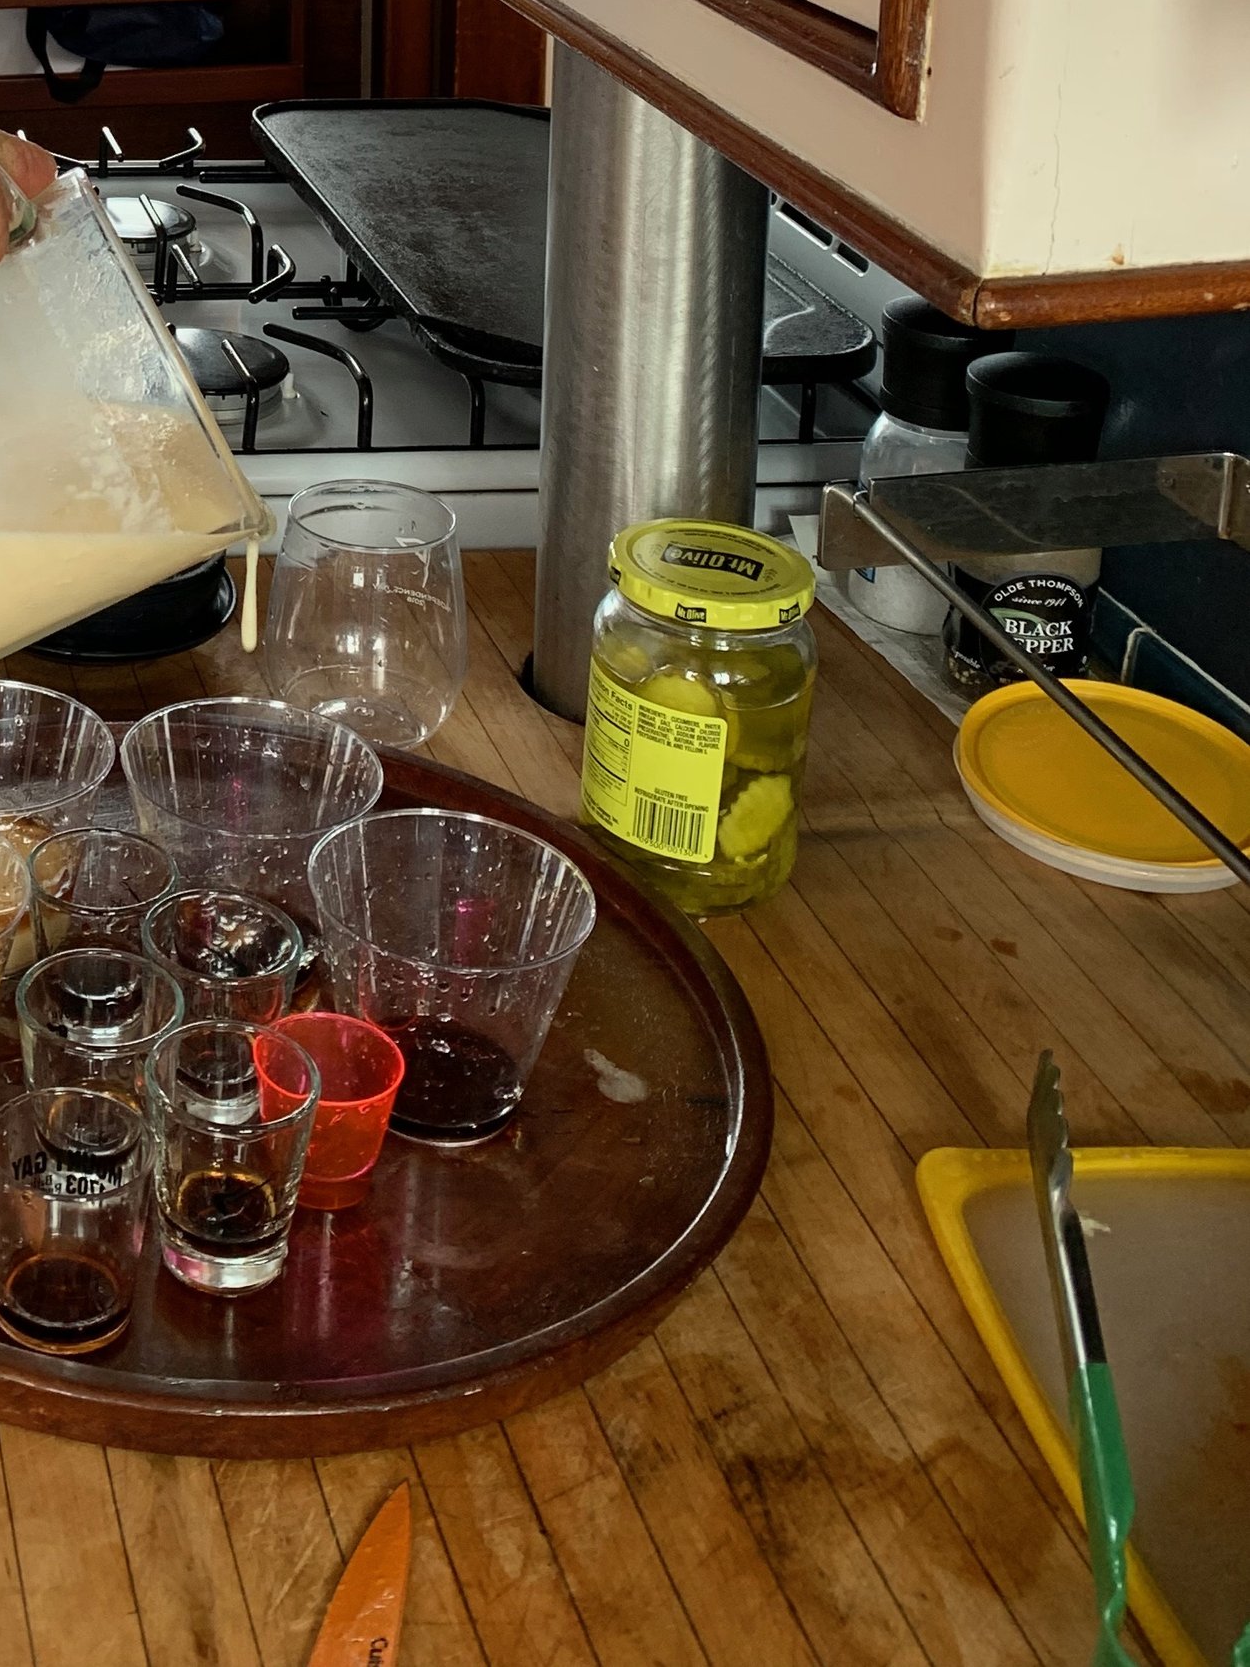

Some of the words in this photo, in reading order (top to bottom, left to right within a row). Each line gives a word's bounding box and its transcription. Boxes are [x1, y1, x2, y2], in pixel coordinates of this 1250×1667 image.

[994, 581, 1026, 602] OLDE
[1028, 579, 1085, 609] THOMPSON
[1011, 595, 1043, 606] since
[1004, 618, 1073, 637] BLACK
[1013, 637, 1075, 654] PPER
[610, 690, 633, 711] Facts
[634, 786, 666, 804] REFRIGERATE
[667, 798, 684, 808] AFTER
[684, 802, 709, 813] OPENING
[654, 787, 674, 799] GLUTEN
[675, 793, 688, 802] FREE
[367, 1637, 389, 1667] Cui
